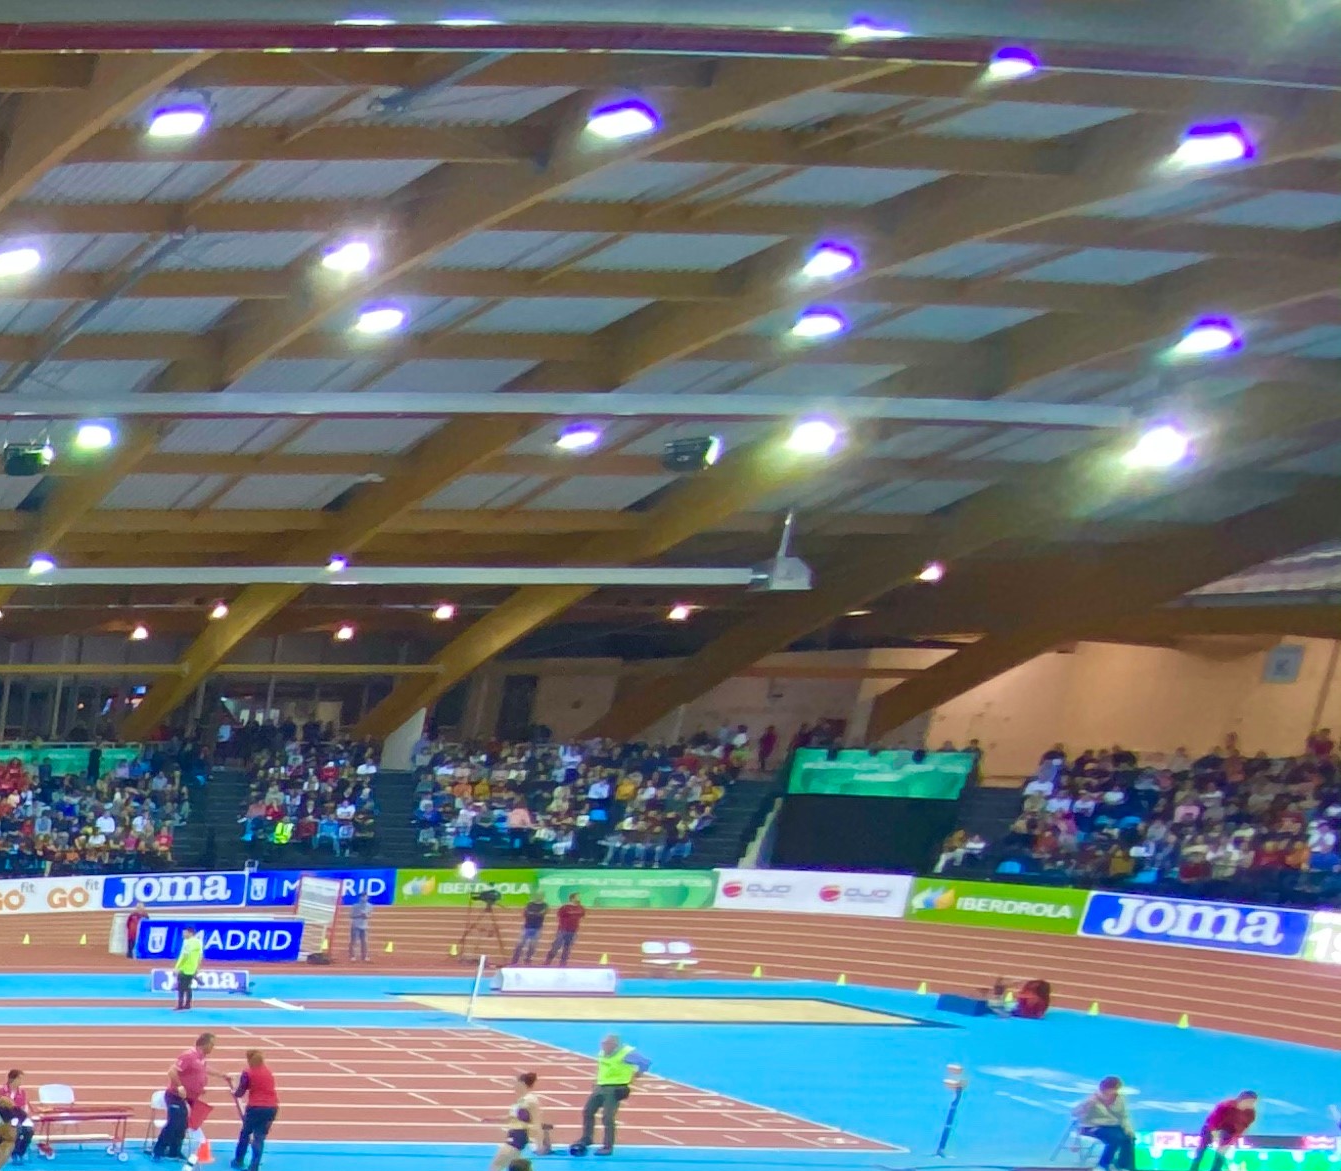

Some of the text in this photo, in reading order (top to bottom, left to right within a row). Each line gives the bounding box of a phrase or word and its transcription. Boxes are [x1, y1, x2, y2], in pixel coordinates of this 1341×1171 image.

[20, 882, 35, 894] fit
[47, 879, 100, 909] GO fit
[282, 878, 387, 897] MRID
[956, 896, 1072, 920] IBERDROLA
[161, 969, 239, 990] Jma
